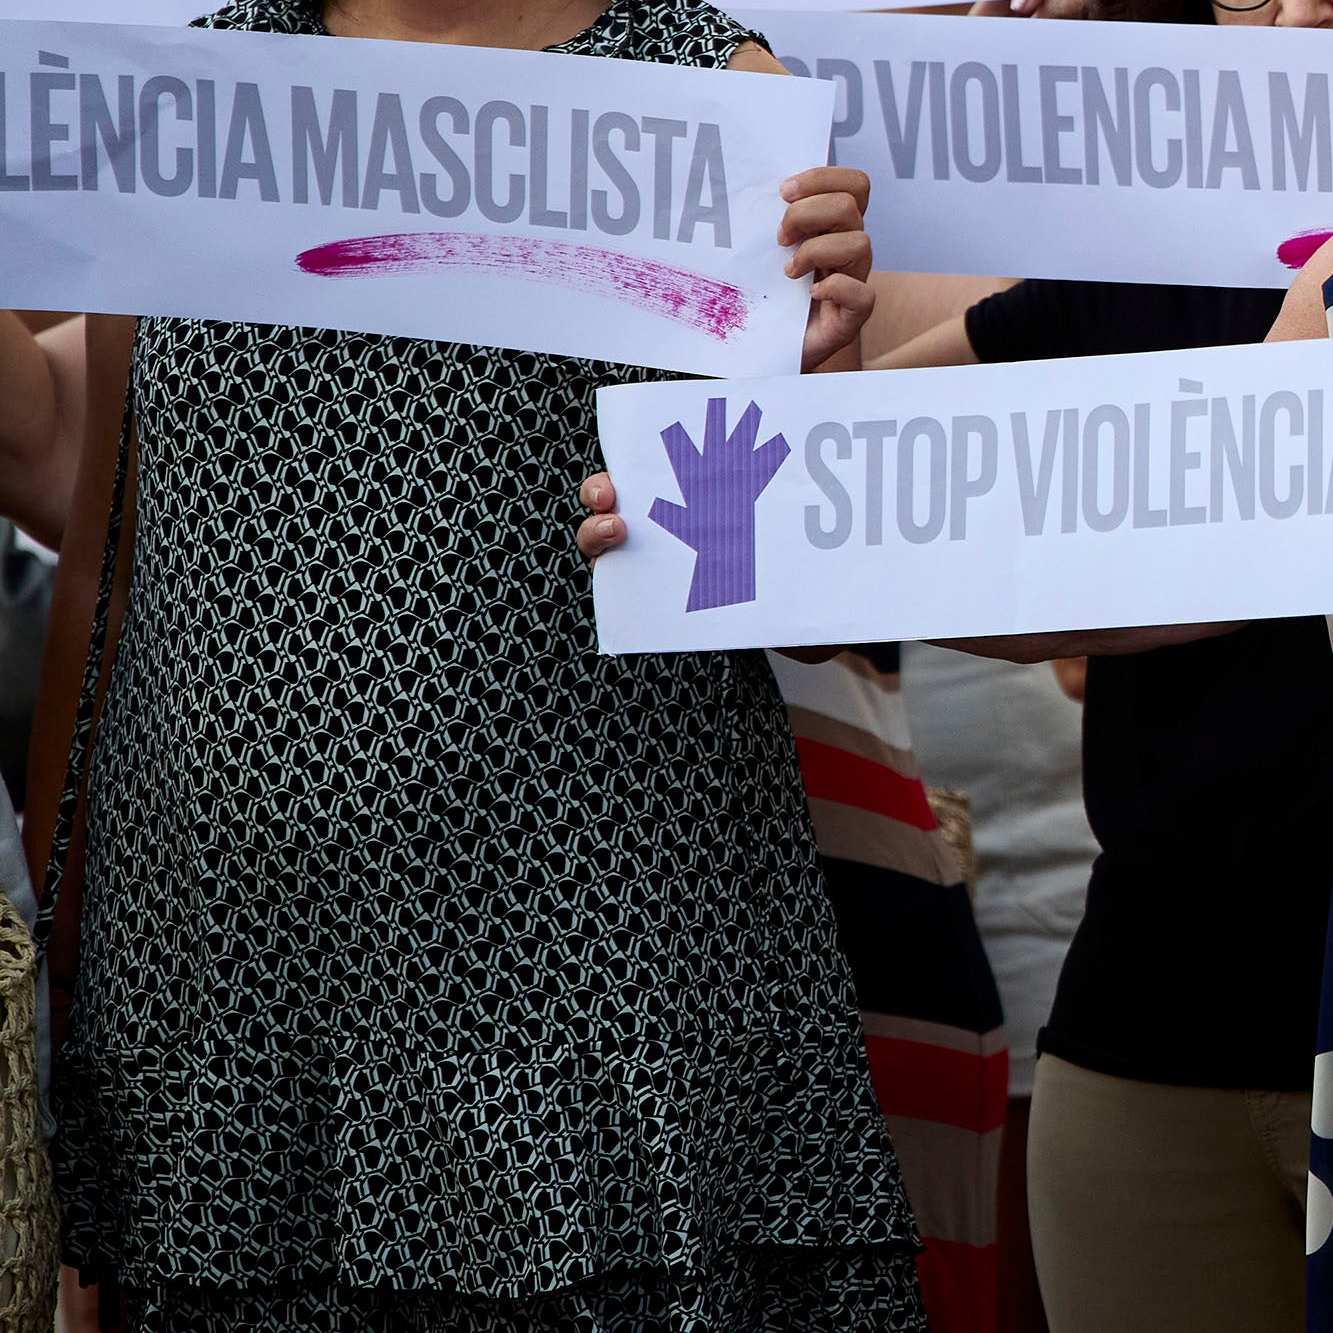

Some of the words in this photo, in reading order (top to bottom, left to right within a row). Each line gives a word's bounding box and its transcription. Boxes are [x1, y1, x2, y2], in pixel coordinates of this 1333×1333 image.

[291, 85, 732, 249] MASCLISTA
[873, 59, 1262, 191] VIOLENCIA
[803, 413, 998, 550] STOP
